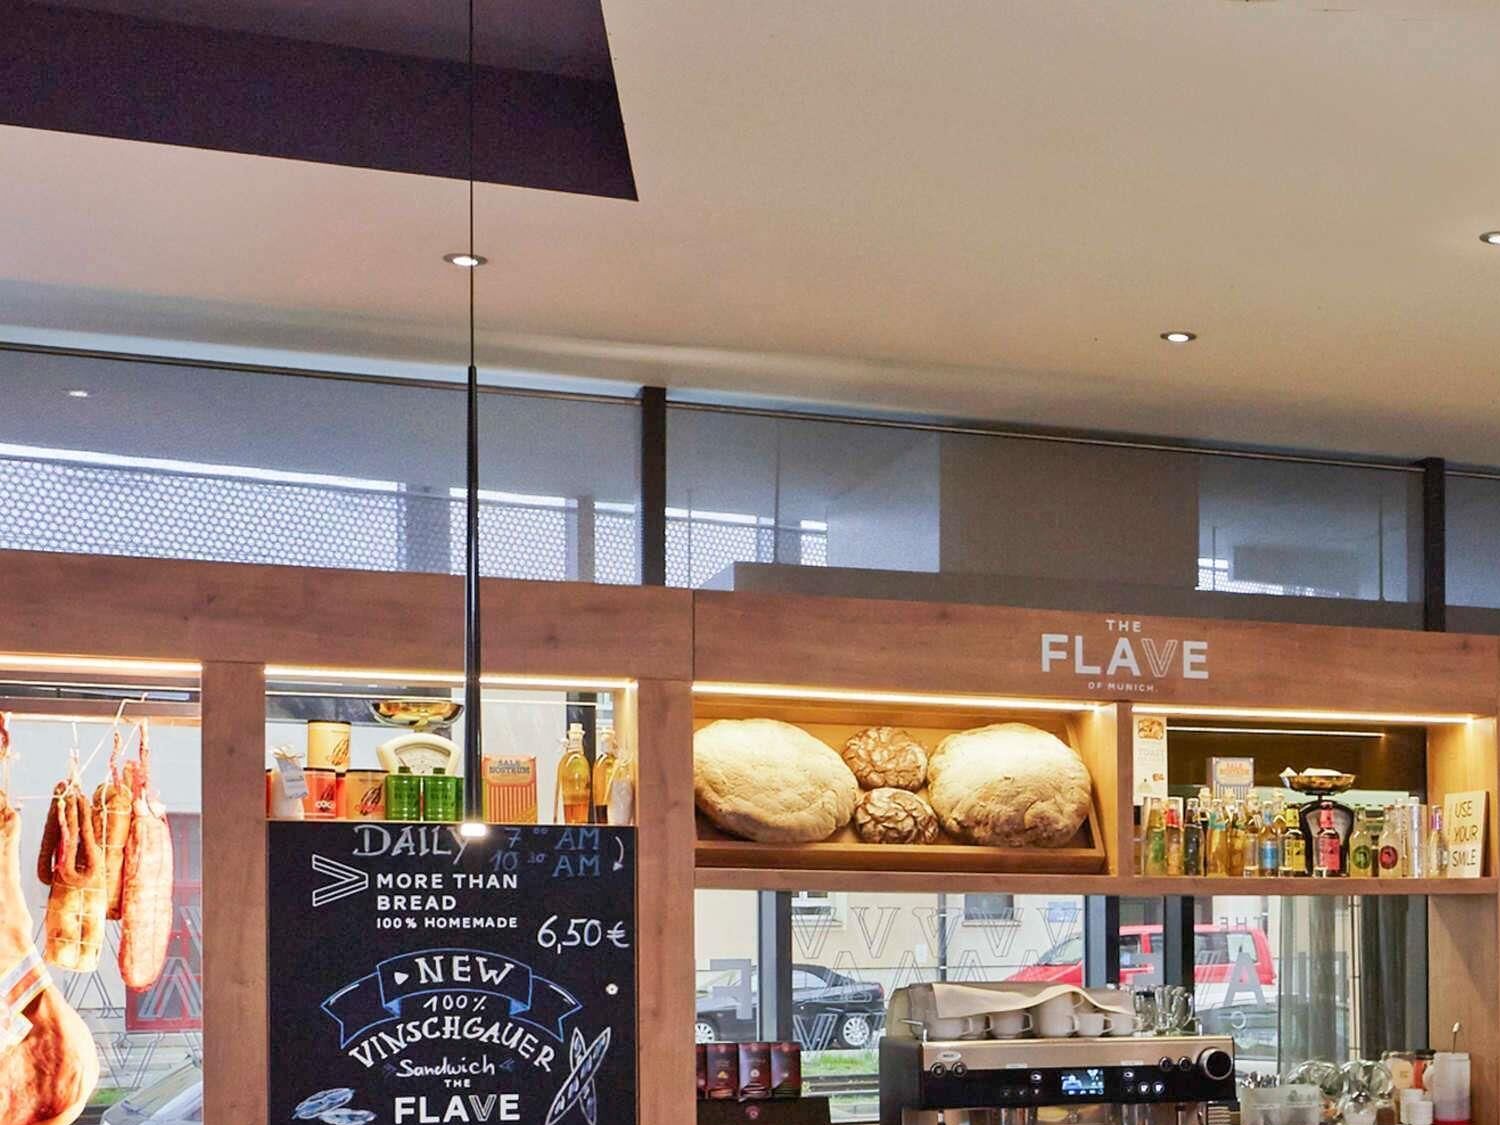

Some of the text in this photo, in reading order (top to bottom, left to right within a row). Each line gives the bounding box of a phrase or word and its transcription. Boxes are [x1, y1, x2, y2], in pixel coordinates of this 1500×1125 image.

[1106, 619, 1142, 633] THE
[1041, 633, 1209, 680] FLAVE
[1088, 682, 1102, 690] OF
[1455, 800, 1473, 818] USE
[1454, 825, 1478, 842] YOUR
[353, 824, 473, 864] DAILY
[554, 826, 601, 850] AM
[552, 854, 601, 878] AM
[1452, 849, 1476, 867] SMILE
[377, 873, 518, 889] MORE THAN
[377, 895, 457, 911] BREAD
[425, 917, 518, 928] HOMEMADE
[414, 954, 515, 986] NEW
[423, 995, 487, 1012] 100%
[348, 1016, 556, 1073] VINSCHGAUER
[395, 1055, 496, 1078] Sandwich
[444, 1079, 471, 1088] THE
[394, 1094, 520, 1124] FLAVE
